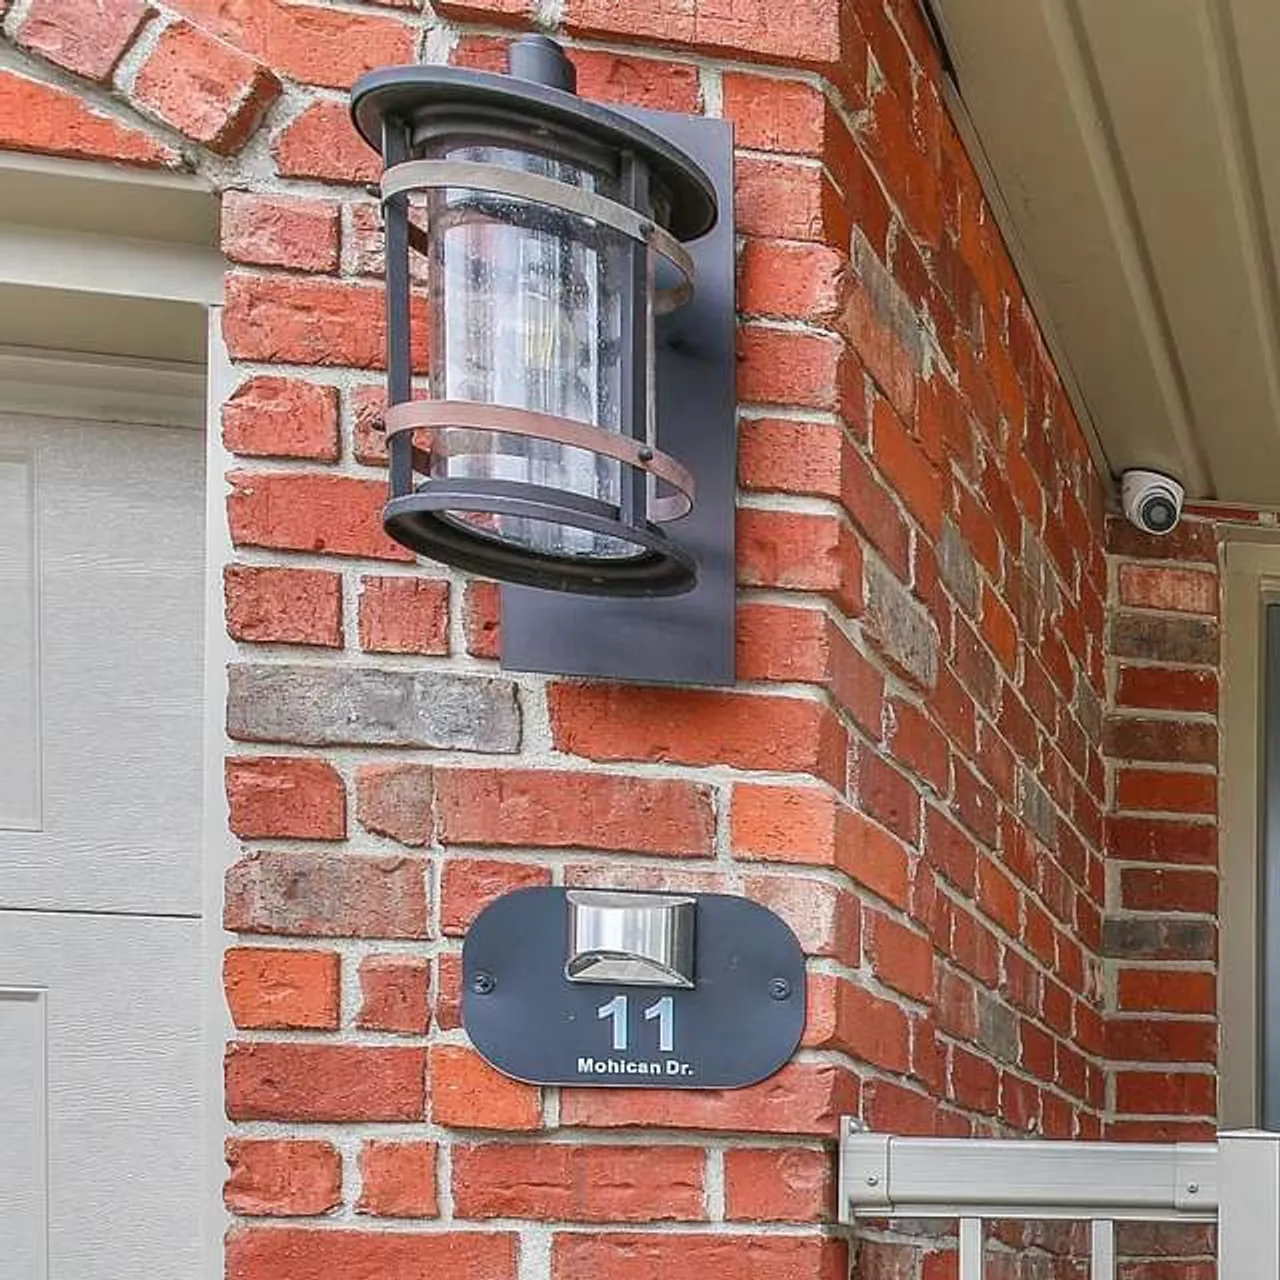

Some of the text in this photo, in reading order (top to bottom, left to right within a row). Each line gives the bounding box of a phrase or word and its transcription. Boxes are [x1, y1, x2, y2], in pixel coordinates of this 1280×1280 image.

[598, 995, 674, 1051] 11
[577, 1057, 694, 1076] Mohican Dr.
